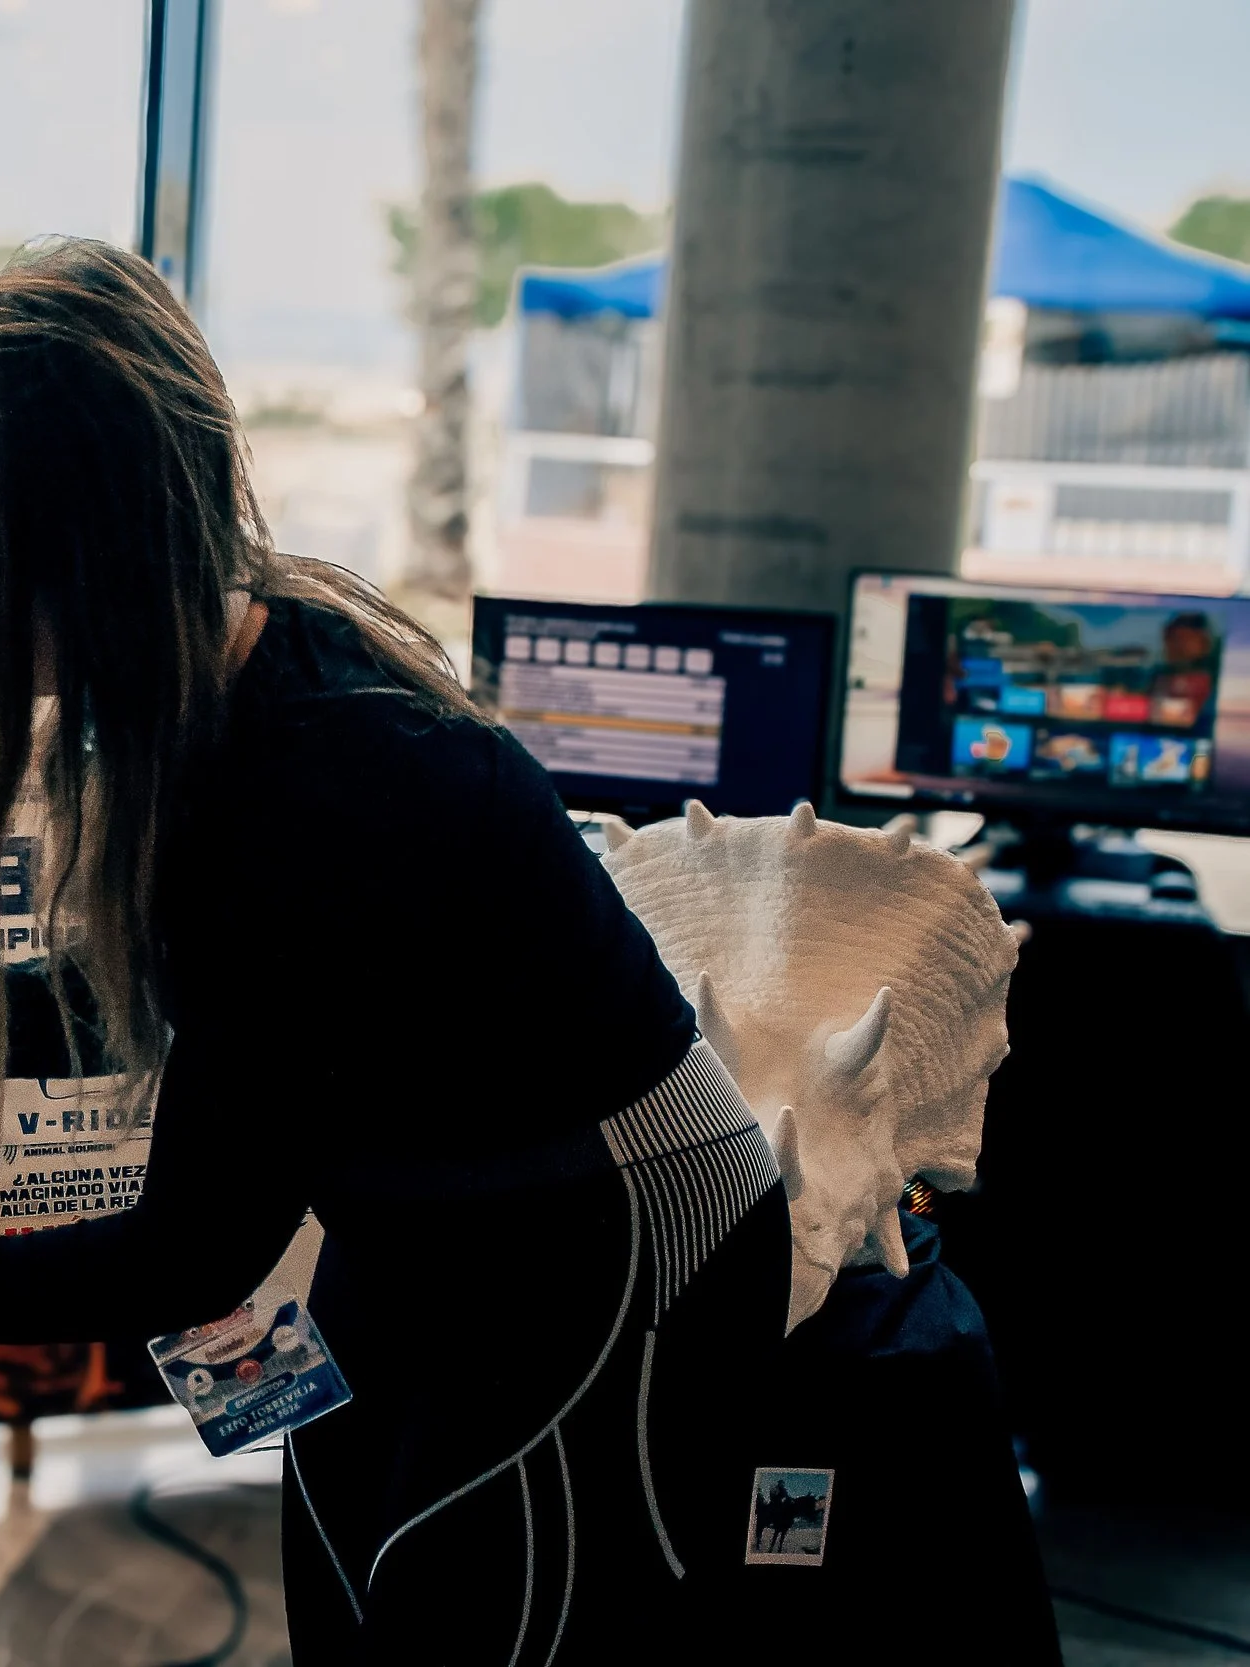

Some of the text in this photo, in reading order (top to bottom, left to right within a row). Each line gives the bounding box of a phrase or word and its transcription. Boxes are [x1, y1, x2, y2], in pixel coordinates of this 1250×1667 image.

[23, 1146, 65, 1158] ANIMAL
[12, 1164, 147, 1187] ¿ALGUNA VEZ
[108, 1180, 146, 1196] VIA
[0, 1201, 50, 1218] ALLA
[54, 1200, 79, 1214] DE
[82, 1197, 106, 1211] LA
[218, 1416, 248, 1437] EXPO
